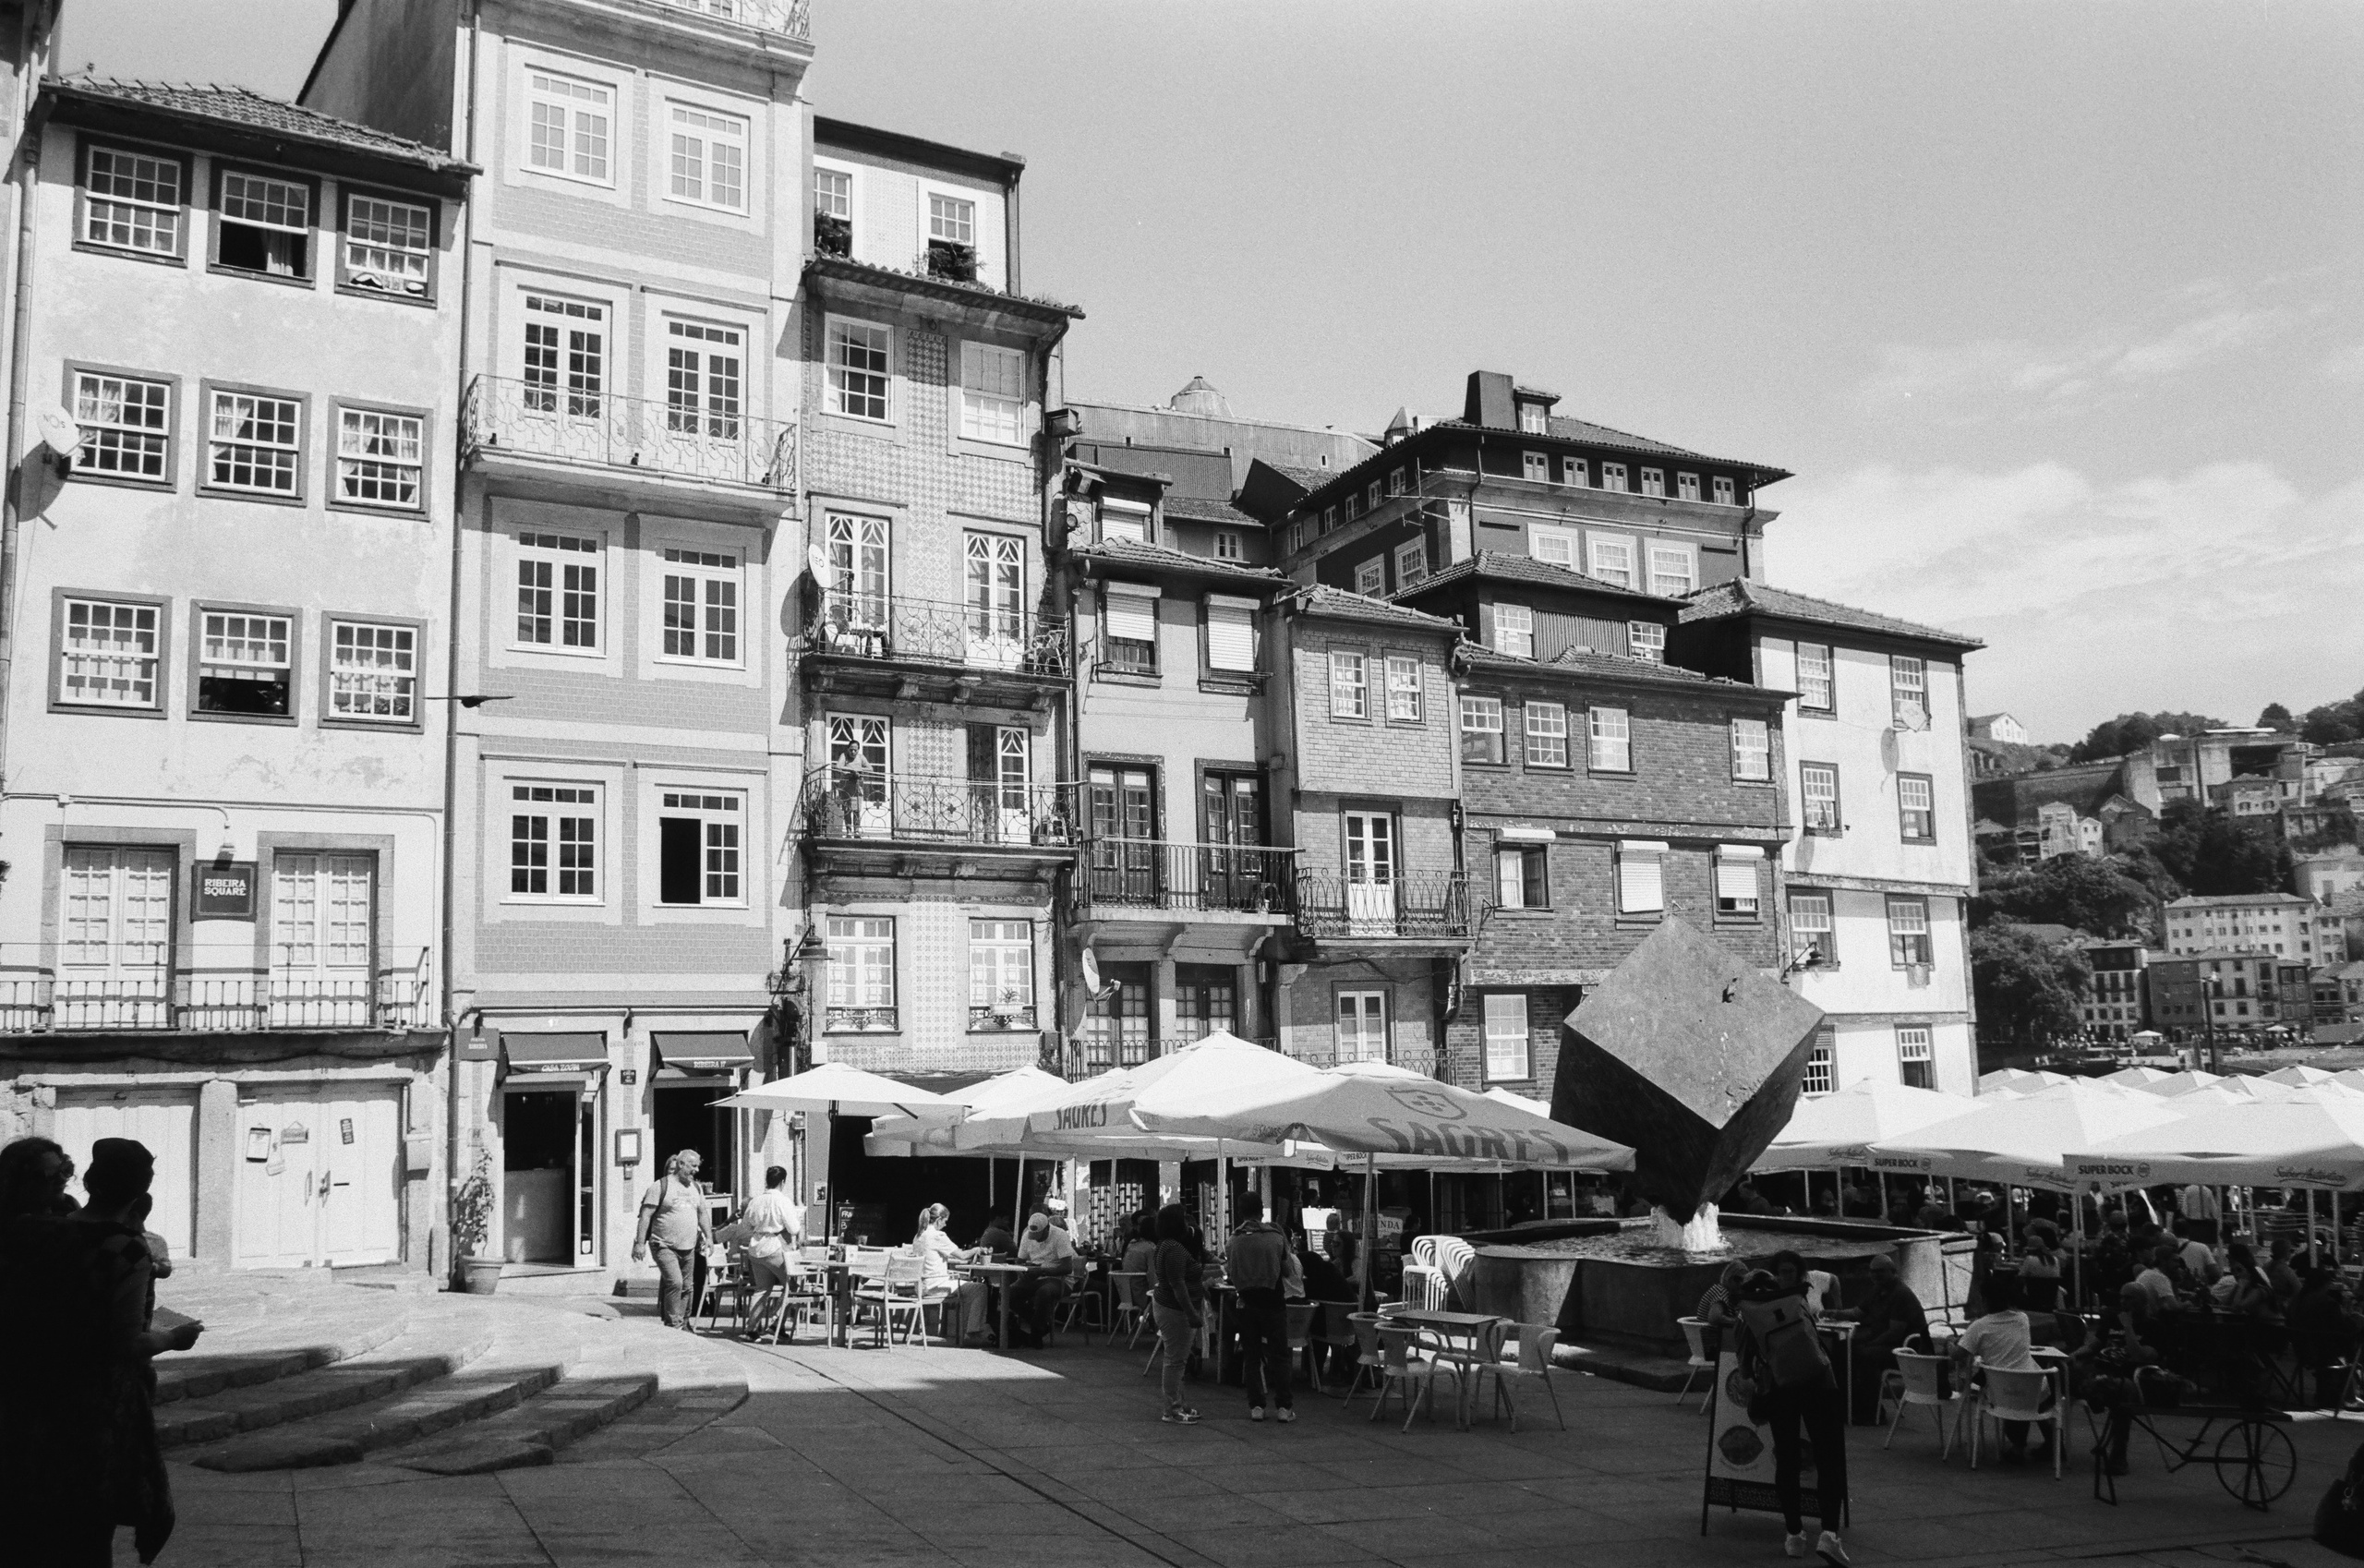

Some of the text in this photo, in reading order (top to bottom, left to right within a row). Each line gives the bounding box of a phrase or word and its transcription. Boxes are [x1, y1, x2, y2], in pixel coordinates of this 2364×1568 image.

[204, 878, 247, 888] RIBEIRA
[204, 887, 247, 897] SQUARE
[1875, 1158, 1918, 1168] SUPER BOCK
[2078, 1164, 2134, 1176] SUPER BOCK
